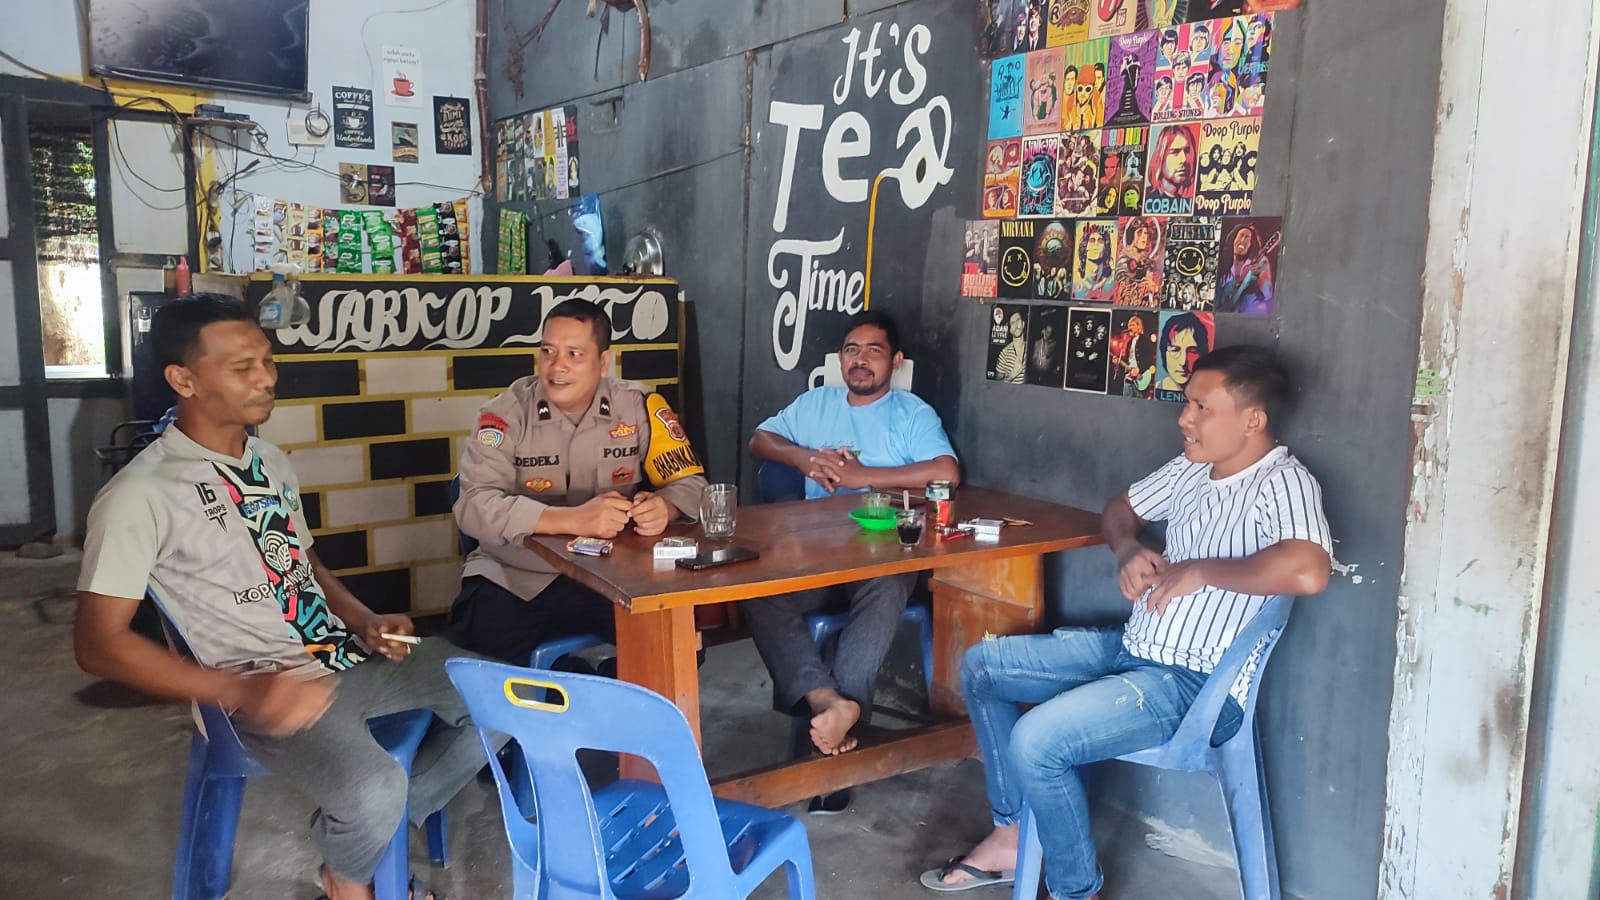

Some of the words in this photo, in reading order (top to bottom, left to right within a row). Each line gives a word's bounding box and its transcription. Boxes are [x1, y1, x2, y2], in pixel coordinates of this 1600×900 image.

[335, 91, 371, 103] COFFEE
[1203, 123, 1228, 141] Deep
[1230, 119, 1260, 141] Purple
[769, 95, 954, 232] Tea
[1144, 198, 1192, 214] COBAIN
[1196, 195, 1220, 216] Deep
[1221, 192, 1251, 215] Purple
[1001, 221, 1034, 237] NIRVANA
[963, 274, 996, 286] ROLLING
[768, 226, 865, 371] Time
[962, 286, 993, 297] STONES
[195, 482, 217, 506] 16
[204, 504, 227, 518] TROPS
[233, 582, 277, 605] KOPI
